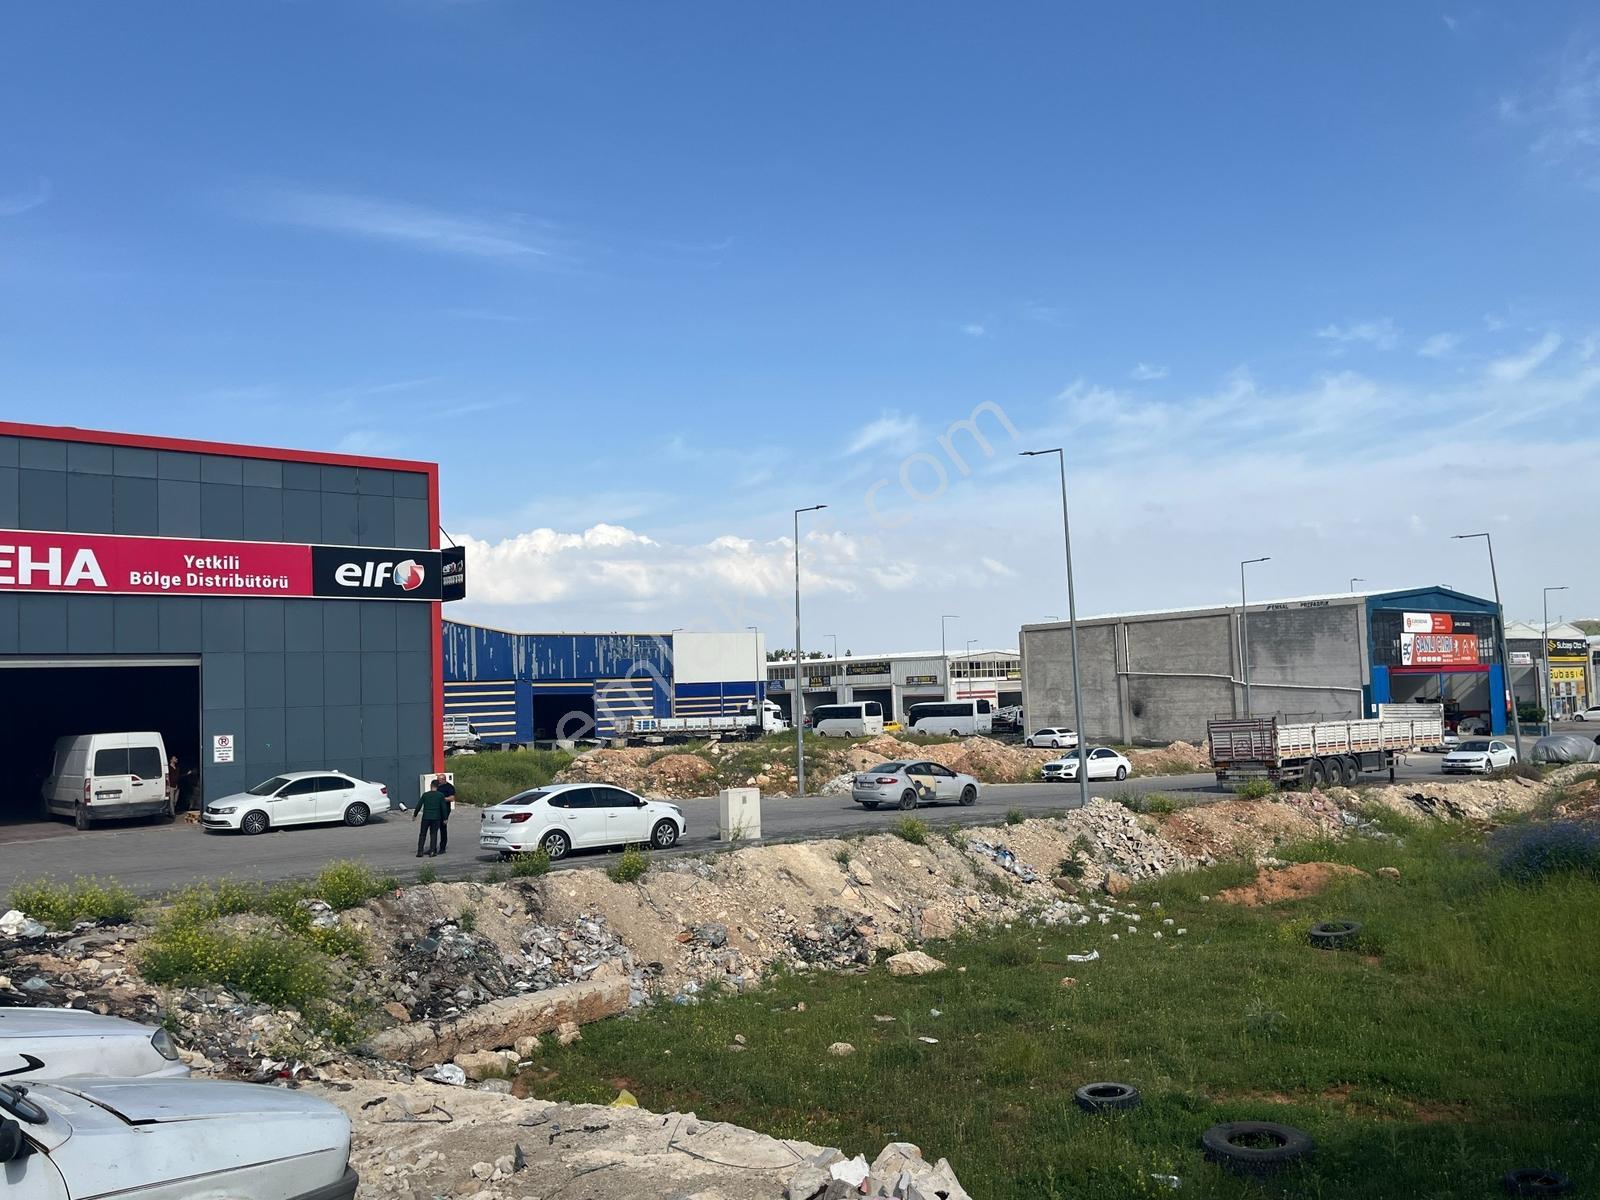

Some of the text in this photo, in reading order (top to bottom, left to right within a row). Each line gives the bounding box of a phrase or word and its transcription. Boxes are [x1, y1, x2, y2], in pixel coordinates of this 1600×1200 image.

[184, 555, 240, 570] Yetkili
[129, 571, 289, 590] Bölge Distribütörü
[335, 562, 394, 588] elf
